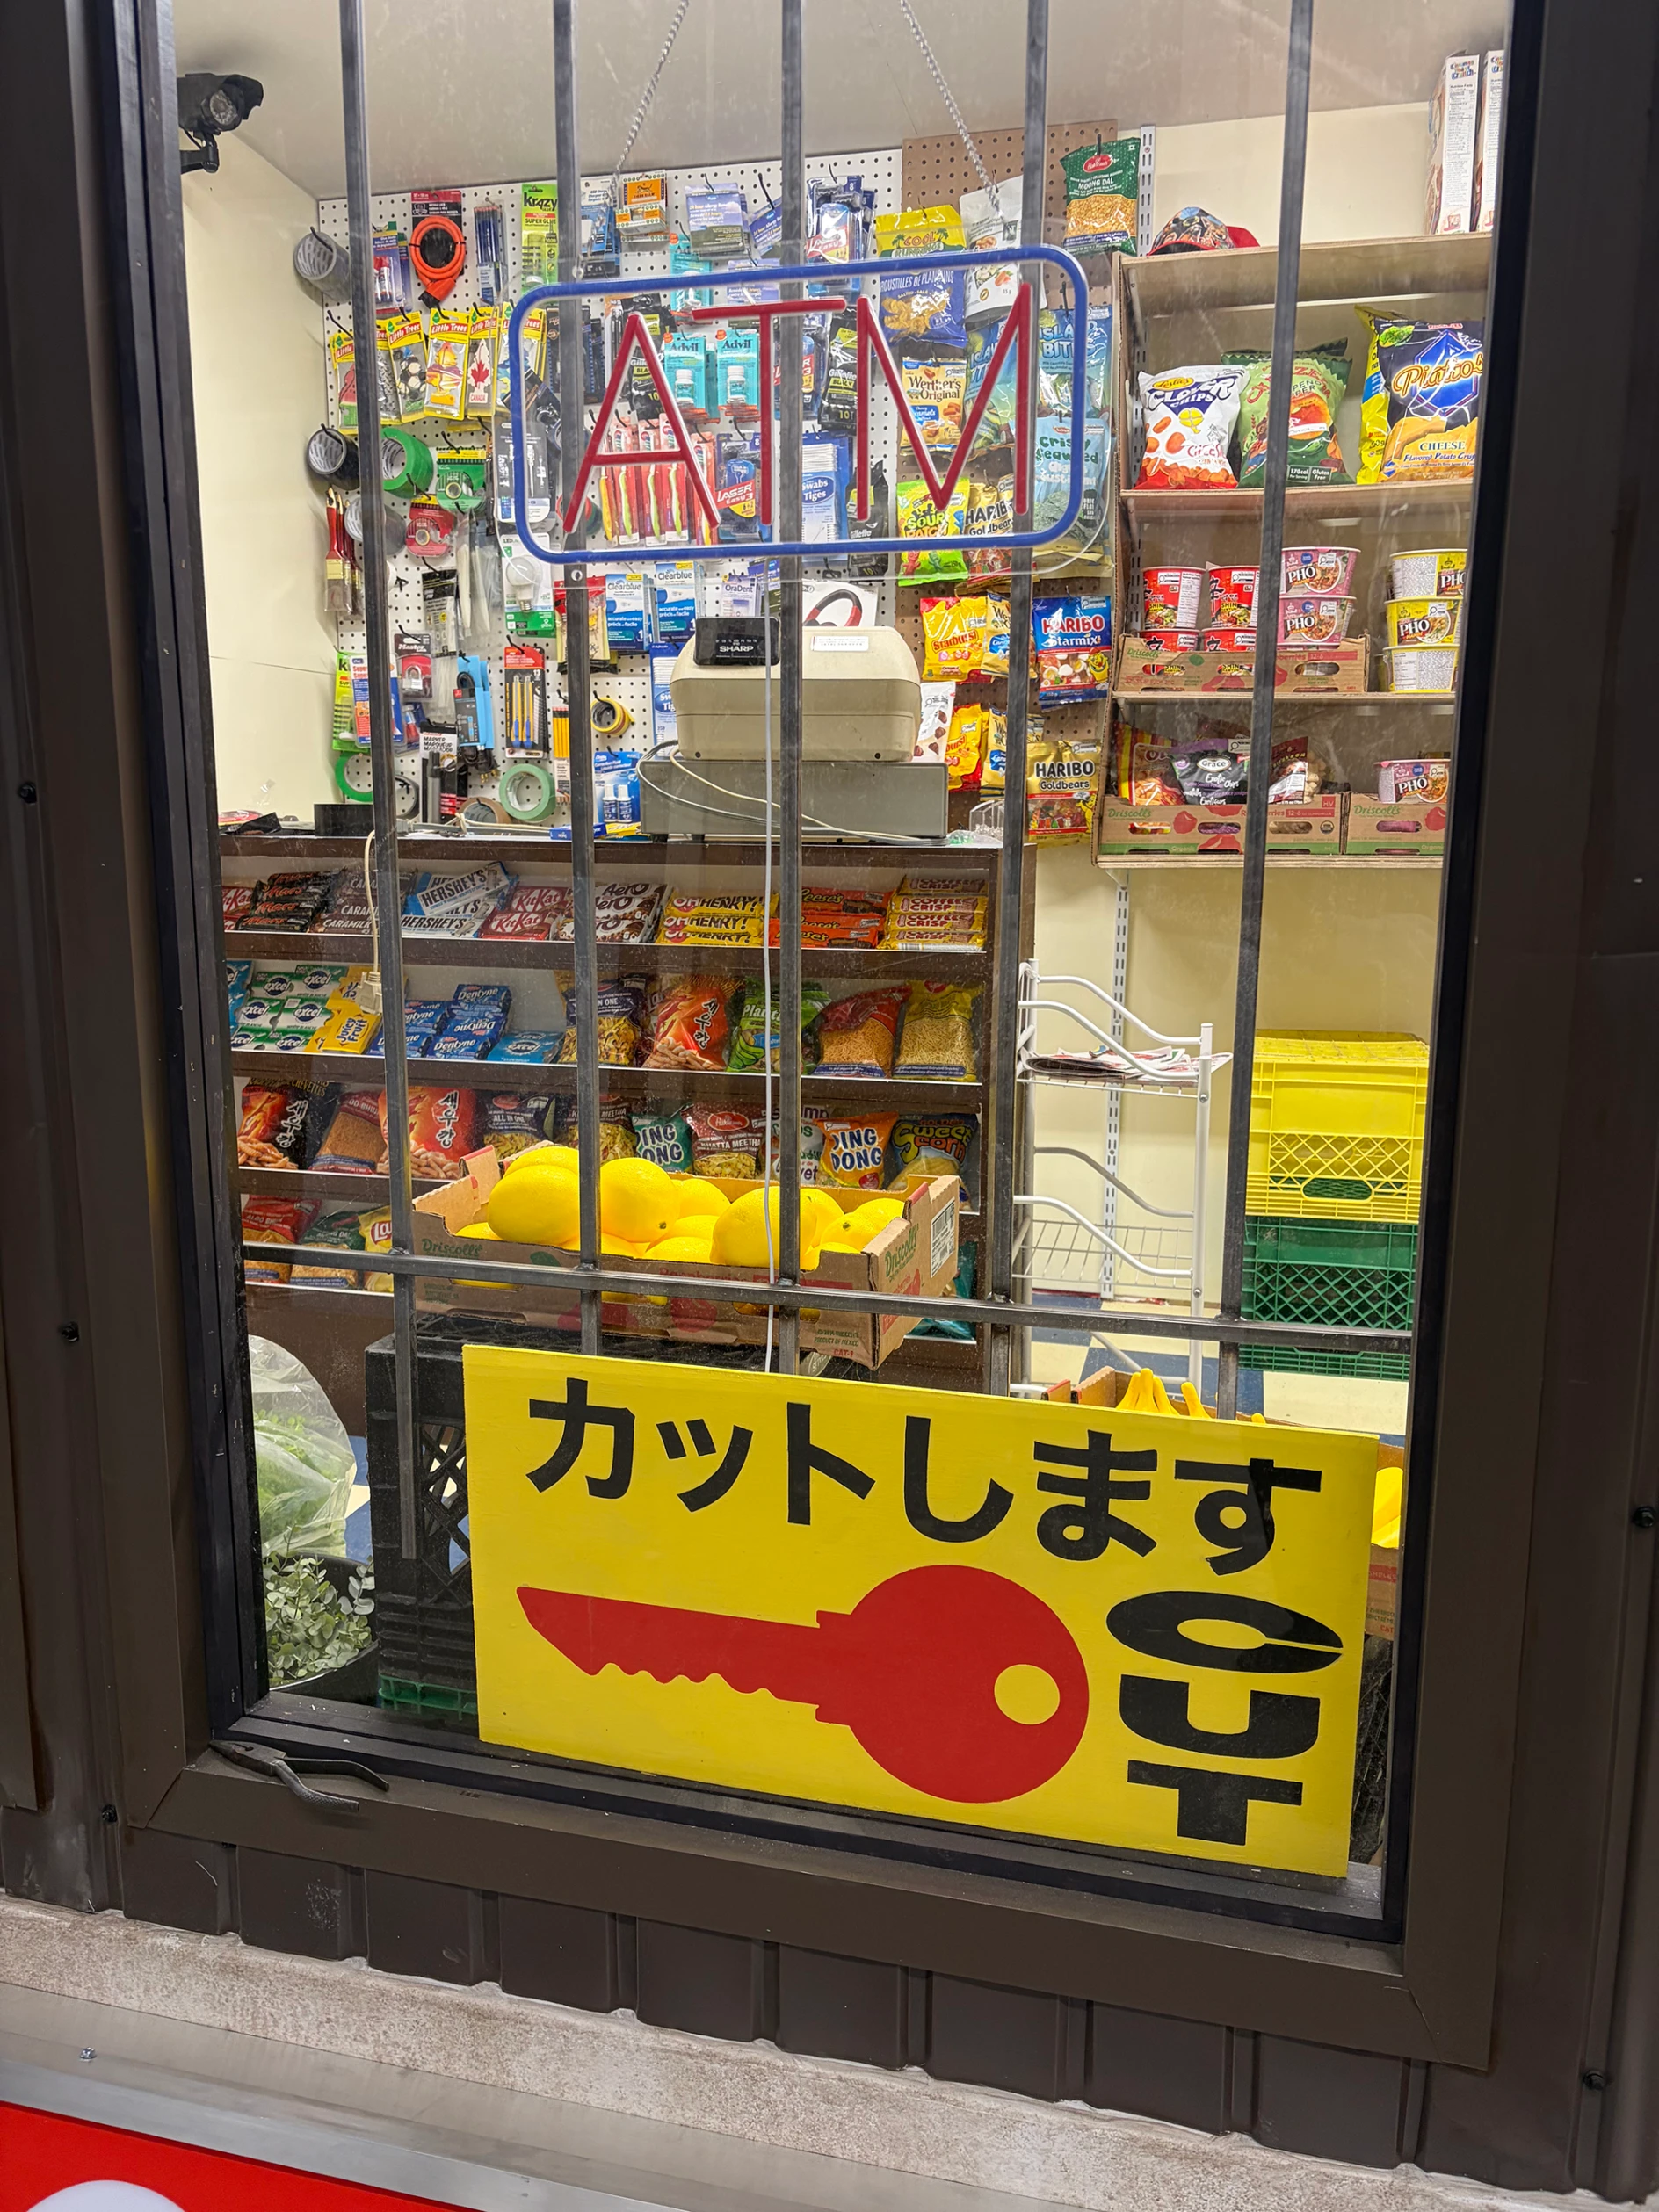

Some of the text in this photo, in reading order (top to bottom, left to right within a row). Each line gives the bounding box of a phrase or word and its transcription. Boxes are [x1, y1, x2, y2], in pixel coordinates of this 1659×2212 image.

[1078, 177, 1114, 190] MOONG DAL
[523, 192, 558, 212] Krazy
[903, 231, 936, 247] COOL
[388, 322, 421, 344] Little Trees
[431, 322, 468, 334] Little Trees
[470, 322, 486, 335] Little
[1040, 320, 1098, 342] ISLAD
[336, 344, 354, 358] Little
[670, 342, 699, 352] Advil
[721, 339, 752, 349] Advil
[1042, 337, 1097, 359] BITS
[829, 369, 857, 380] Gillette
[909, 375, 962, 391] Werther's
[920, 389, 960, 403] Original
[1148, 376, 1237, 412] CLOVER
[1170, 393, 1214, 408] CHIPS
[563, 282, 1034, 533] ATM
[839, 409, 851, 420] 10
[1039, 435, 1091, 449] Crisy
[1419, 441, 1466, 451] CHEESE
[716, 485, 754, 503] LASER
[804, 490, 827, 502] Tiges
[966, 500, 1012, 525] HARIB
[907, 513, 946, 529] SOUR
[969, 518, 1012, 536] Goldbear
[658, 570, 692, 581] Clearblue
[1287, 566, 1316, 583] PHO
[1440, 571, 1466, 588] PHO
[607, 582, 641, 591] Clearblue
[725, 584, 753, 593] OraDent
[1041, 614, 1105, 634] HARIBO
[1286, 615, 1315, 633] PHO
[1399, 618, 1430, 637] PHO
[1046, 634, 1098, 647] Starmix
[1127, 647, 1161, 659] Driscoll's
[1036, 760, 1095, 777] HARIBO
[1201, 759, 1227, 769] Grace
[1040, 779, 1090, 792] Goldbears
[1205, 773, 1226, 784] Exotic
[1224, 778, 1239, 789] Chips
[1398, 777, 1429, 794] PHO
[1107, 807, 1152, 819] Driscoll's
[1353, 804, 1401, 817] Driscoll's
[264, 885, 303, 899] Mars
[421, 868, 487, 907] HERSHEY'S
[602, 883, 650, 897] Aero
[255, 901, 299, 914] Mars
[517, 889, 560, 912] KitKat
[596, 896, 633, 910] ero
[673, 895, 759, 913] OH HENRY!
[243, 916, 286, 925] Mars
[322, 918, 373, 929] CARAMILK
[401, 916, 467, 929] HERSHEY'S
[496, 913, 540, 933] KitKat
[663, 916, 747, 930] OH HENRY!
[303, 972, 331, 986] excel
[264, 980, 291, 994] excel
[457, 987, 498, 1001] Dentyne
[605, 997, 619, 1007] ONE
[242, 1004, 269, 1016] excel
[293, 1006, 322, 1018] excel
[336, 1017, 353, 1043] Juicy
[346, 1018, 368, 1043] Fruit
[453, 1020, 496, 1032] Dentyne
[276, 1037, 304, 1048] excel
[433, 1038, 476, 1051] Dentyne
[507, 1040, 541, 1052] excel
[291, 1079, 327, 1097] CREVETTES
[435, 1089, 460, 1149] 새우깡
[601, 1107, 627, 1117] MEETHA
[275, 1099, 308, 1148] 새우깡
[700, 1138, 762, 1150] KHATTA MEETHA
[892, 1121, 973, 1165] Sweet
[915, 1135, 966, 1164] corn
[831, 1147, 883, 1171] DONG
[421, 1238, 482, 1255] Driscoll's
[884, 1222, 920, 1279] Driscoll's
[841, 1338, 859, 1348] MEXICO
[526, 1377, 1322, 1576] カットします
[1105, 1589, 1343, 1846] CUT
